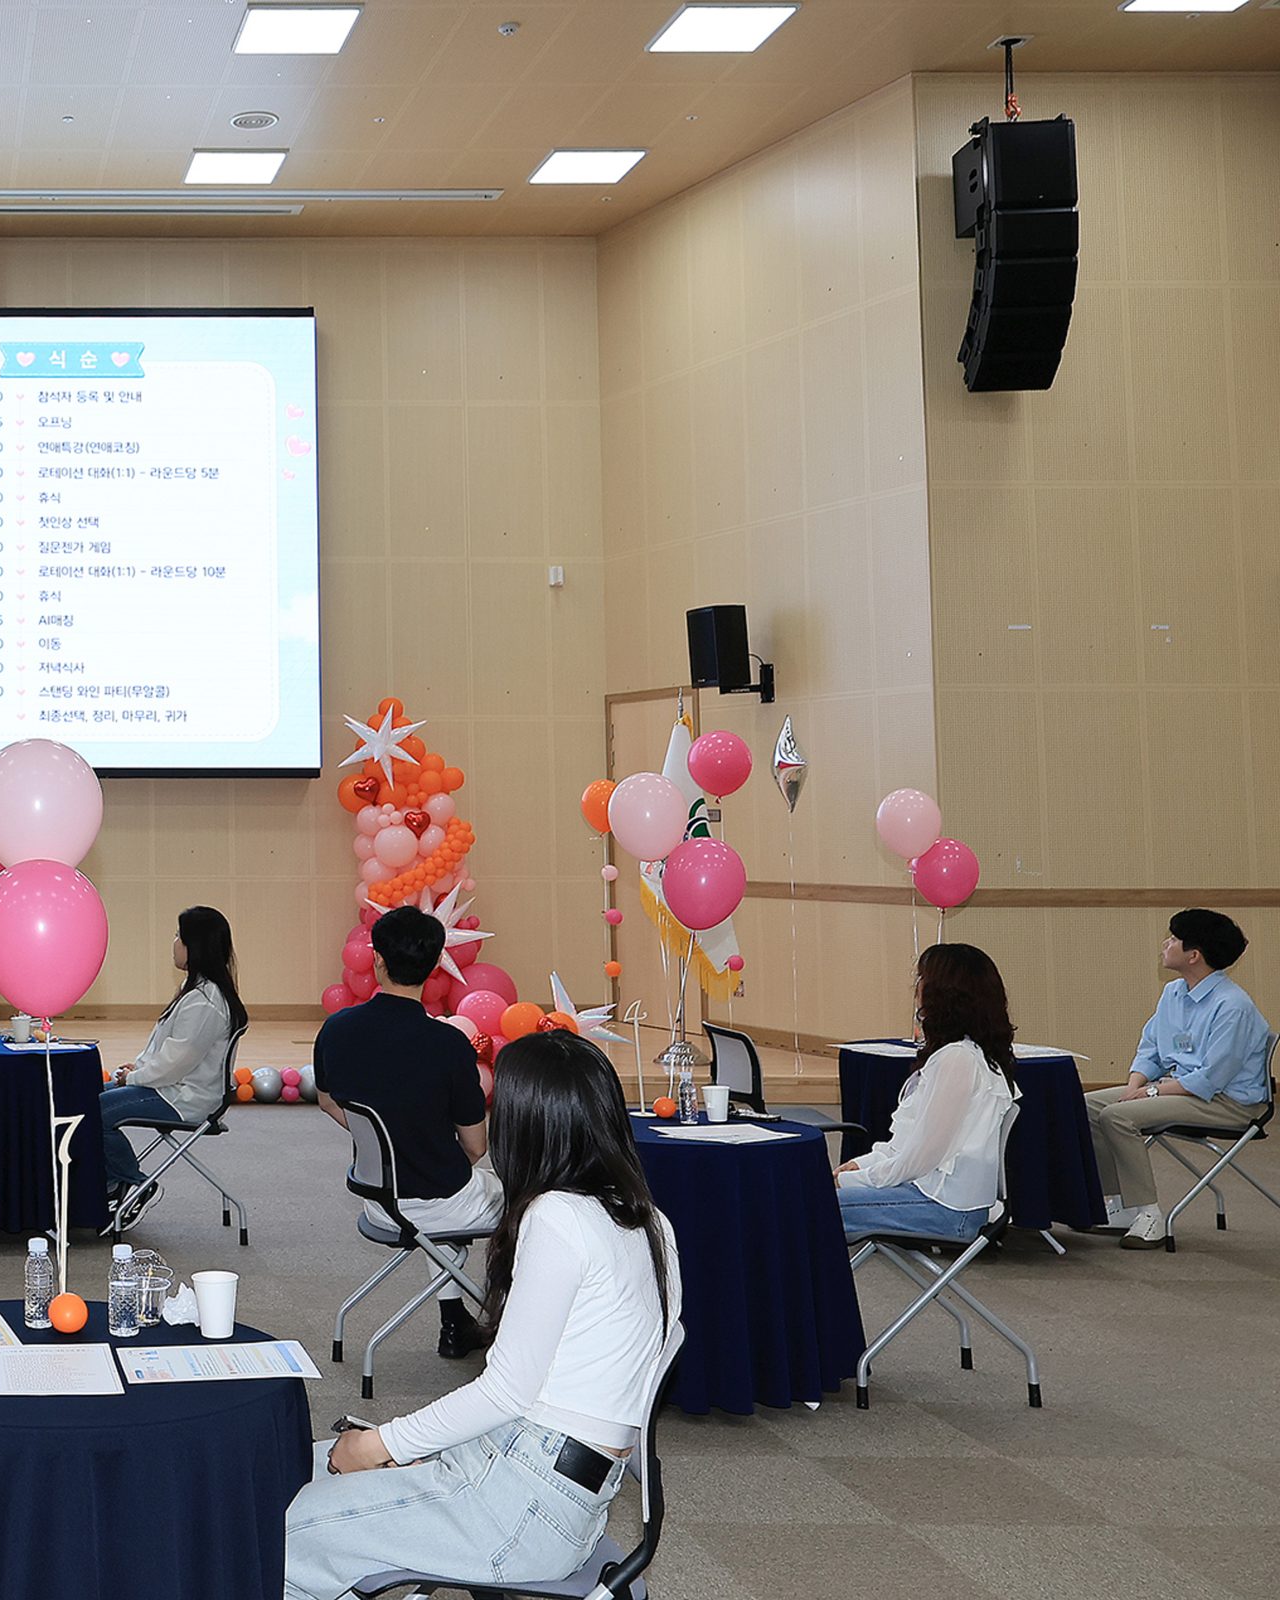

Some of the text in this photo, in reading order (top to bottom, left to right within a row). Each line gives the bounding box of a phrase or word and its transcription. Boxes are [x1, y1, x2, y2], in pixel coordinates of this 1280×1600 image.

[48, 349, 99, 369] 식 순
[118, 390, 142, 404] 안내
[38, 417, 72, 429] 오프닝
[38, 467, 83, 479] 로테이션
[88, 467, 135, 479] 대화(1:1)
[150, 467, 197, 480] 라운드당
[38, 492, 61, 504] 휴식
[38, 516, 72, 529] 첫인상
[77, 516, 99, 529] 선택
[89, 541, 111, 554] 게임
[38, 566, 84, 579] 로테이션
[88, 566, 136, 578] 대화(1:1)
[151, 565, 197, 579] 라운드당
[202, 566, 226, 579] 10분
[39, 590, 61, 602] 휴식
[38, 615, 74, 627] AI매칭
[38, 637, 61, 651] 이동
[38, 662, 85, 674] 저녁식사
[39, 685, 73, 698] 스탠딩
[77, 685, 100, 698] 와인
[39, 709, 88, 723] 최종선택,
[92, 710, 118, 723] 정리,
[122, 710, 160, 723] 마무리,
[165, 710, 187, 722] 귀가
